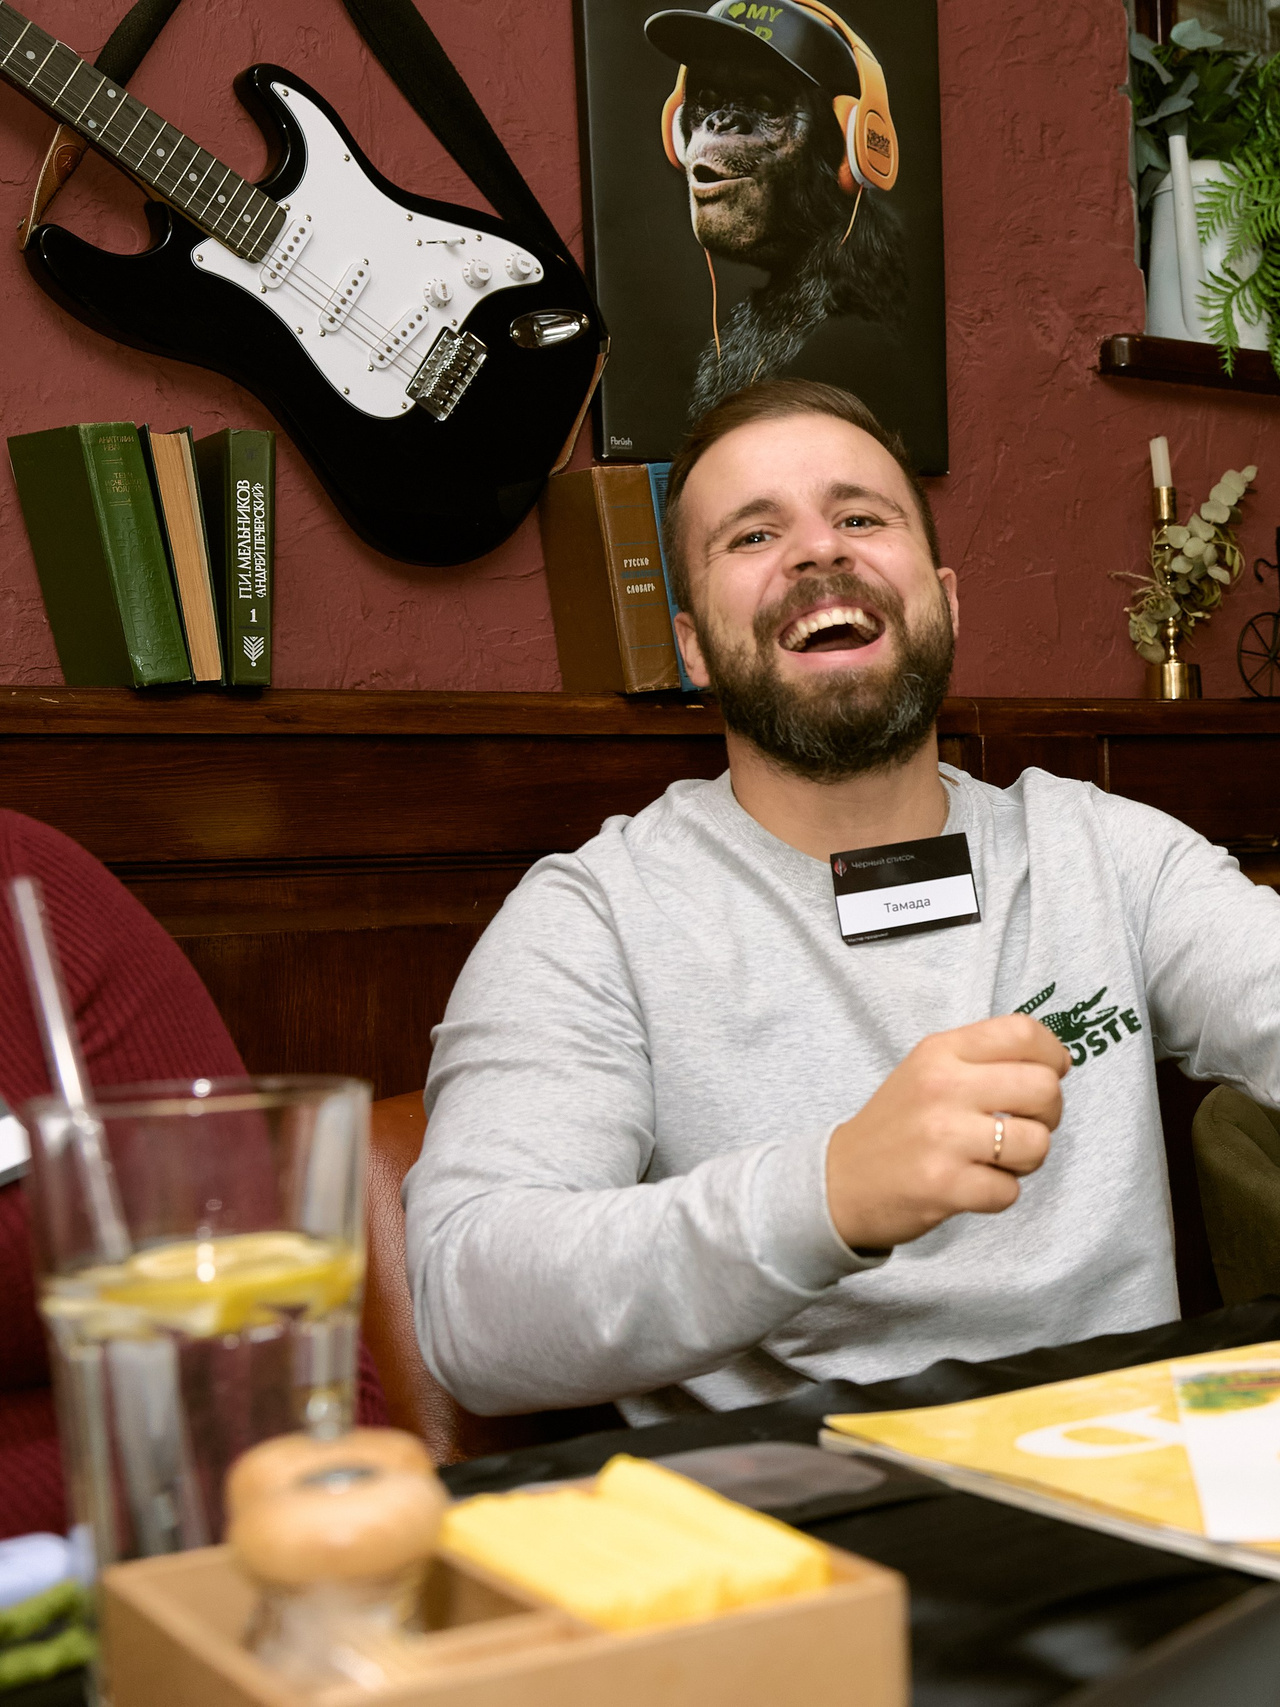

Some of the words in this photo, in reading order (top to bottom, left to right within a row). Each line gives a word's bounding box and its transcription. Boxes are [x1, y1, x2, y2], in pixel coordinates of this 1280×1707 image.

[746, 3, 783, 22] MY
[237, 479, 252, 570] МЕЛЬНИКОВ
[626, 583, 656, 594] СЛОВАРЬ
[250, 608, 257, 623] 1
[883, 898, 931, 913] Тамада
[1065, 1008, 1142, 1066] OSTE
